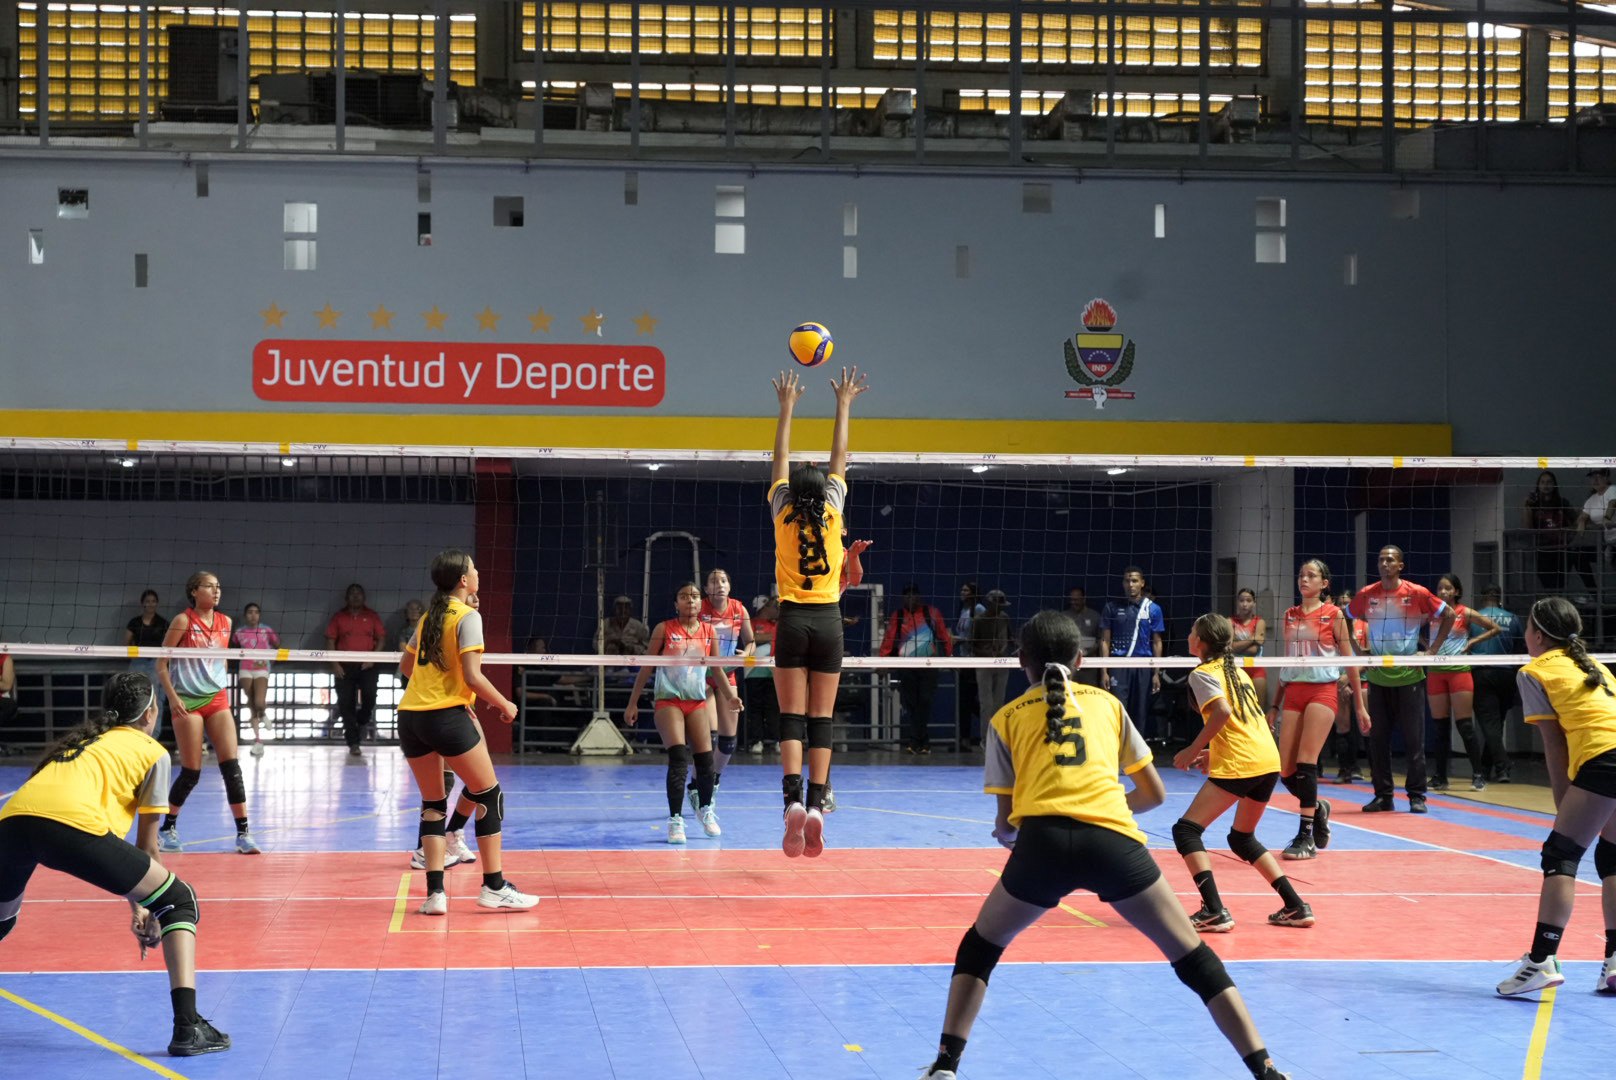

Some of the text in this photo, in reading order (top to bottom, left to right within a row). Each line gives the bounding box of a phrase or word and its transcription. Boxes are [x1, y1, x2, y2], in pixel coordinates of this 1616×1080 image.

[262, 349, 655, 399] Juventud y Deporte
[1092, 364, 1107, 372] IND
[1054, 716, 1087, 767] 5
